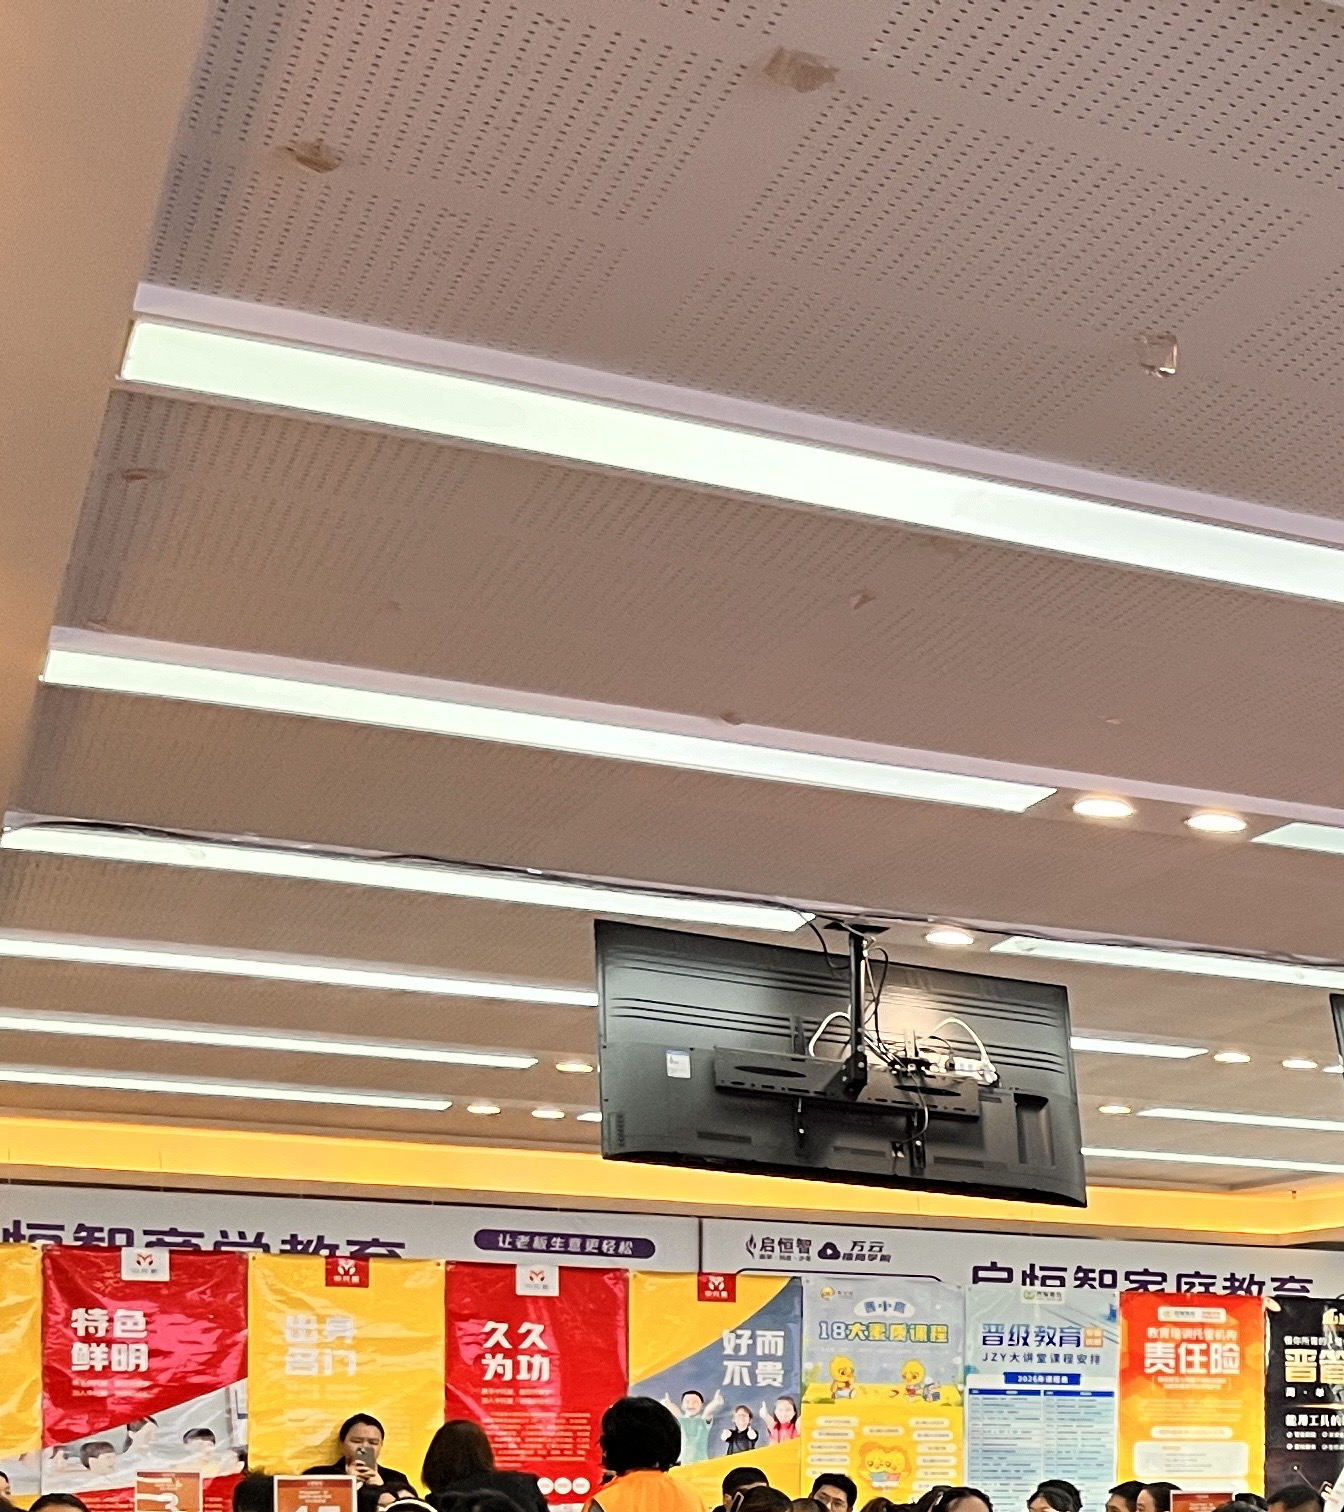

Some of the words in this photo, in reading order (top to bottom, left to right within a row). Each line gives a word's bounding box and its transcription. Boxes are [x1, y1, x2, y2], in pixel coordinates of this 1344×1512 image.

[498, 1233, 634, 1256] 让老板生意更轻松
[759, 1236, 812, 1255] 启恒智
[71, 1307, 148, 1338] 特色
[284, 1313, 357, 1345] 出身
[480, 1320, 550, 1351] 久久
[981, 1323, 1082, 1348] 晋级教育
[71, 1342, 149, 1373] 鲜明
[722, 1329, 785, 1357] 好而
[284, 1347, 358, 1377] 名门
[480, 1353, 551, 1382] 为功
[1143, 1341, 1241, 1376] 责任险
[722, 1360, 785, 1388] 不贵
